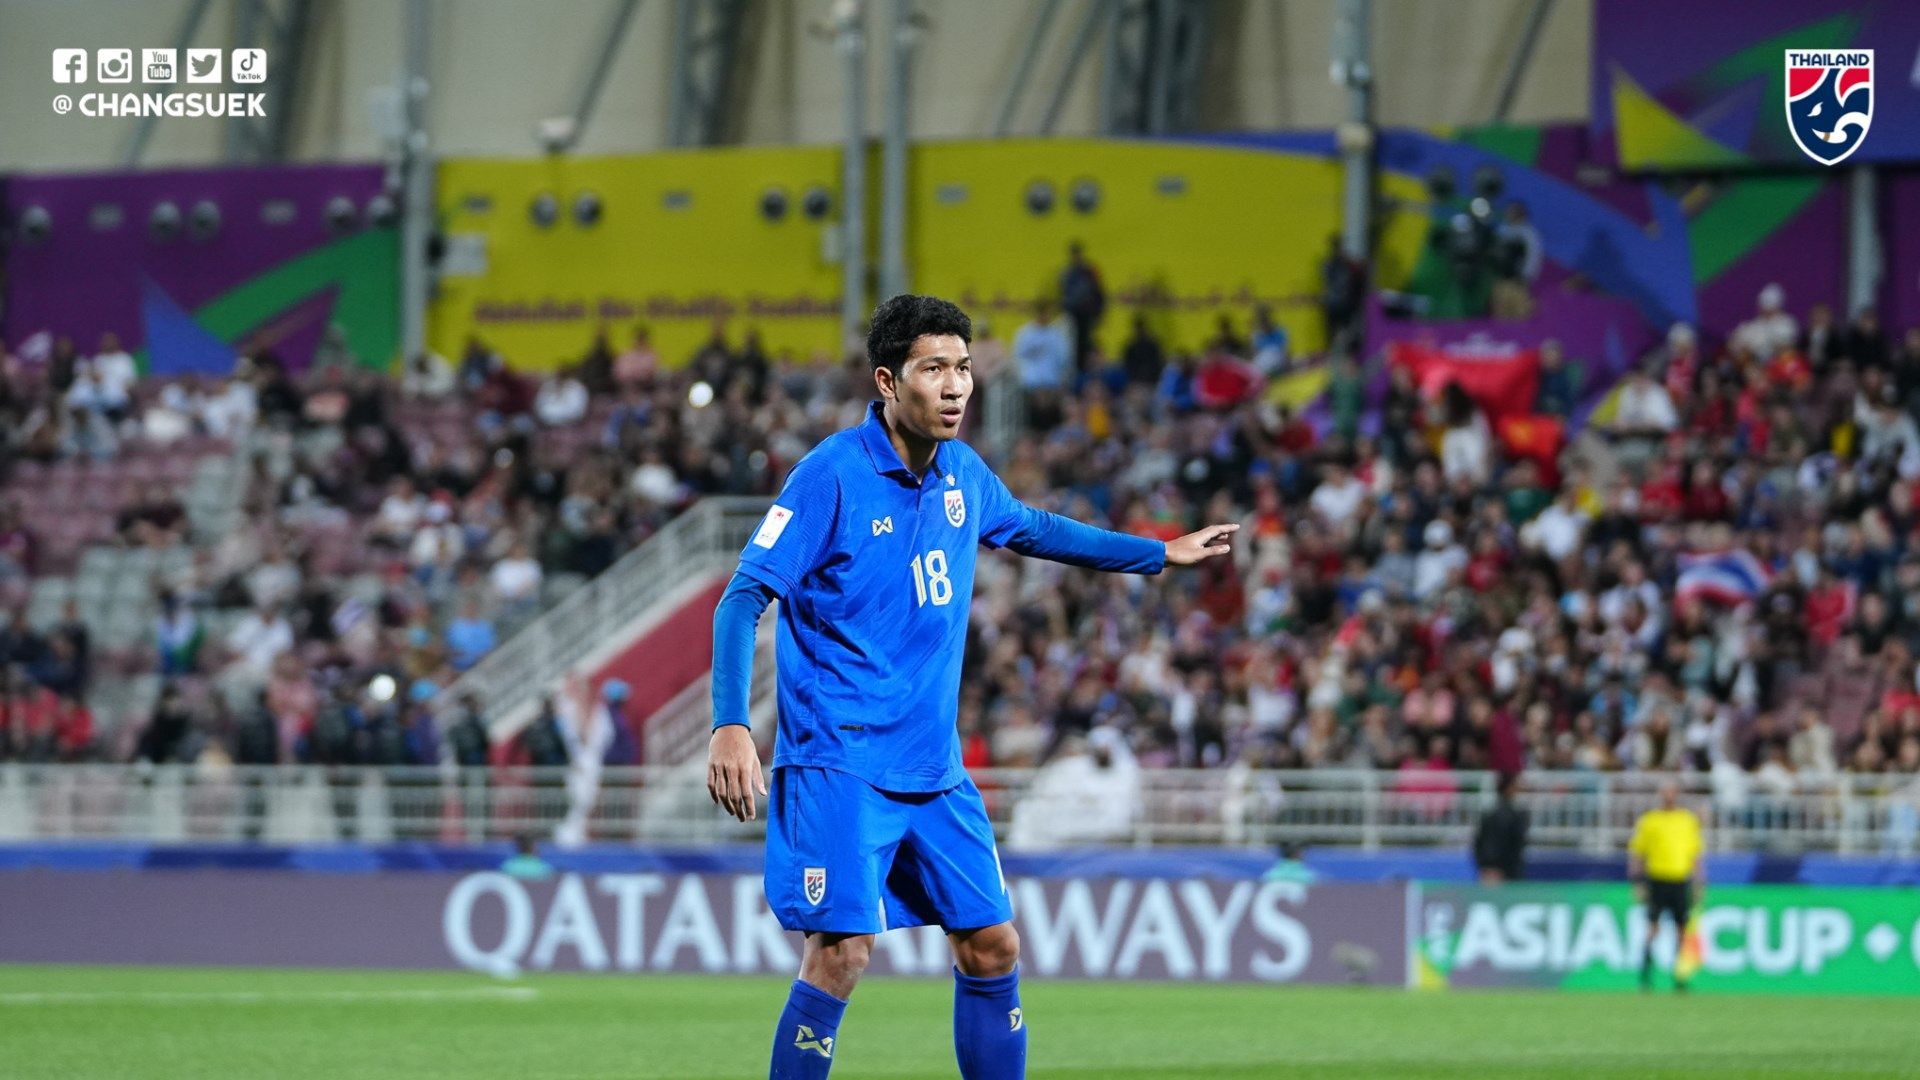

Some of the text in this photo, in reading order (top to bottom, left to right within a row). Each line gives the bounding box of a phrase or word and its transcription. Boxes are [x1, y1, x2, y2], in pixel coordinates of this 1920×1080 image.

[910, 550, 953, 608] 18
[443, 871, 801, 980] QATAR
[1455, 902, 1678, 970] ASIAN
[1696, 904, 1853, 974] CUP
